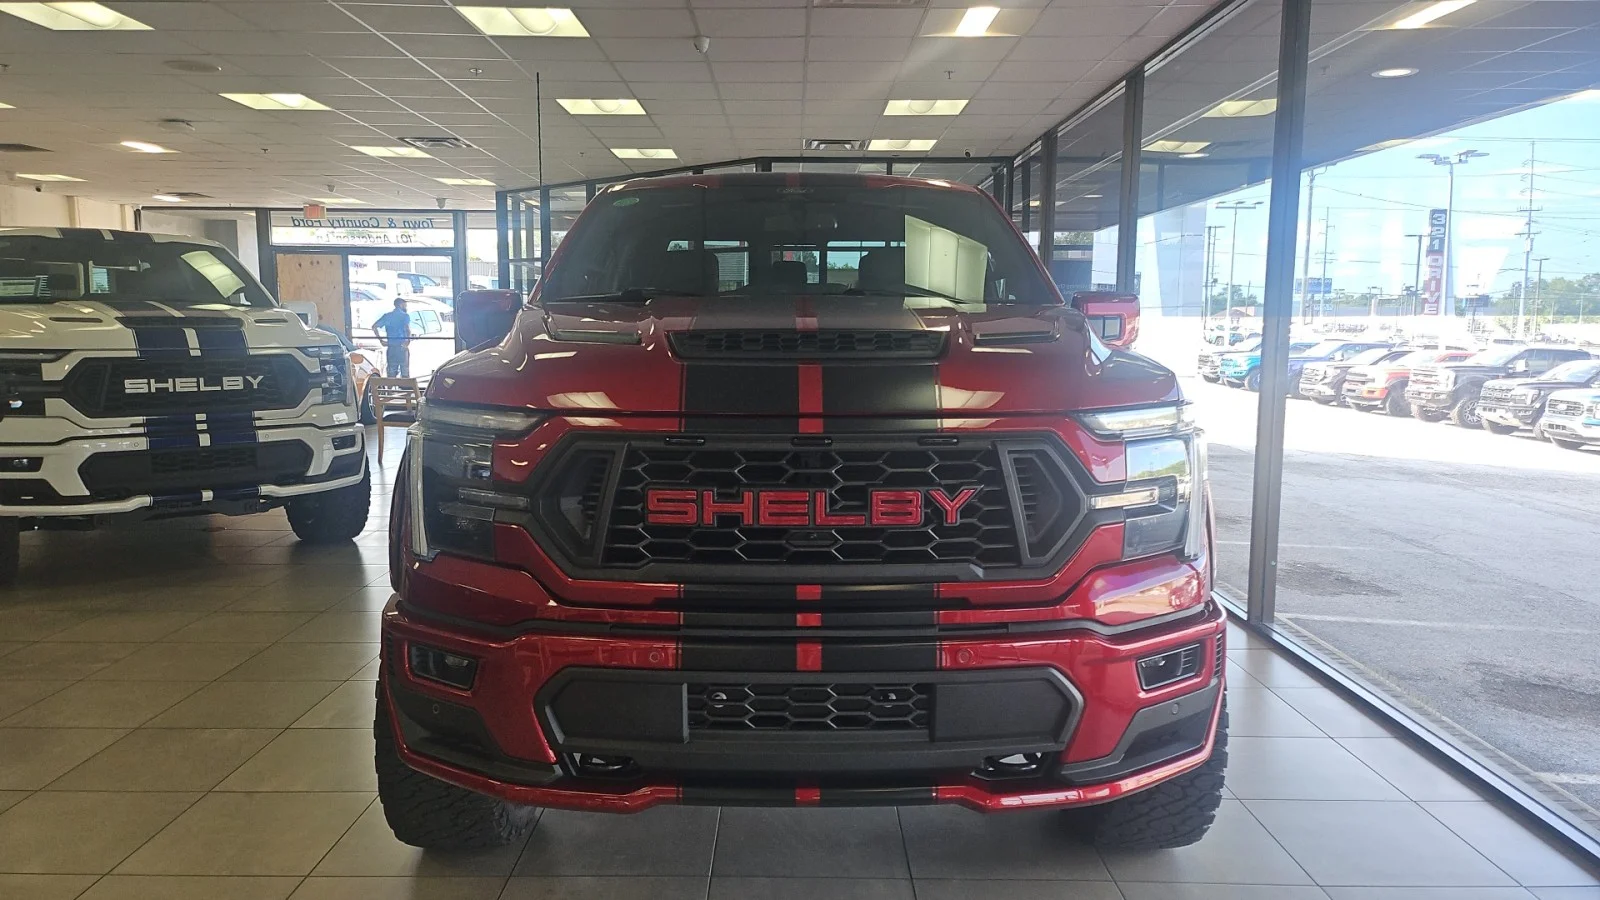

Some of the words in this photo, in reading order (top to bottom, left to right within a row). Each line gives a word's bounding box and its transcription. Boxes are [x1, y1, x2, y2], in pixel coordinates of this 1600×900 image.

[1431, 213, 1446, 250] 321
[1424, 255, 1442, 315] DRIVE
[124, 375, 264, 393] SHELBY
[646, 486, 980, 526] SHELBY
